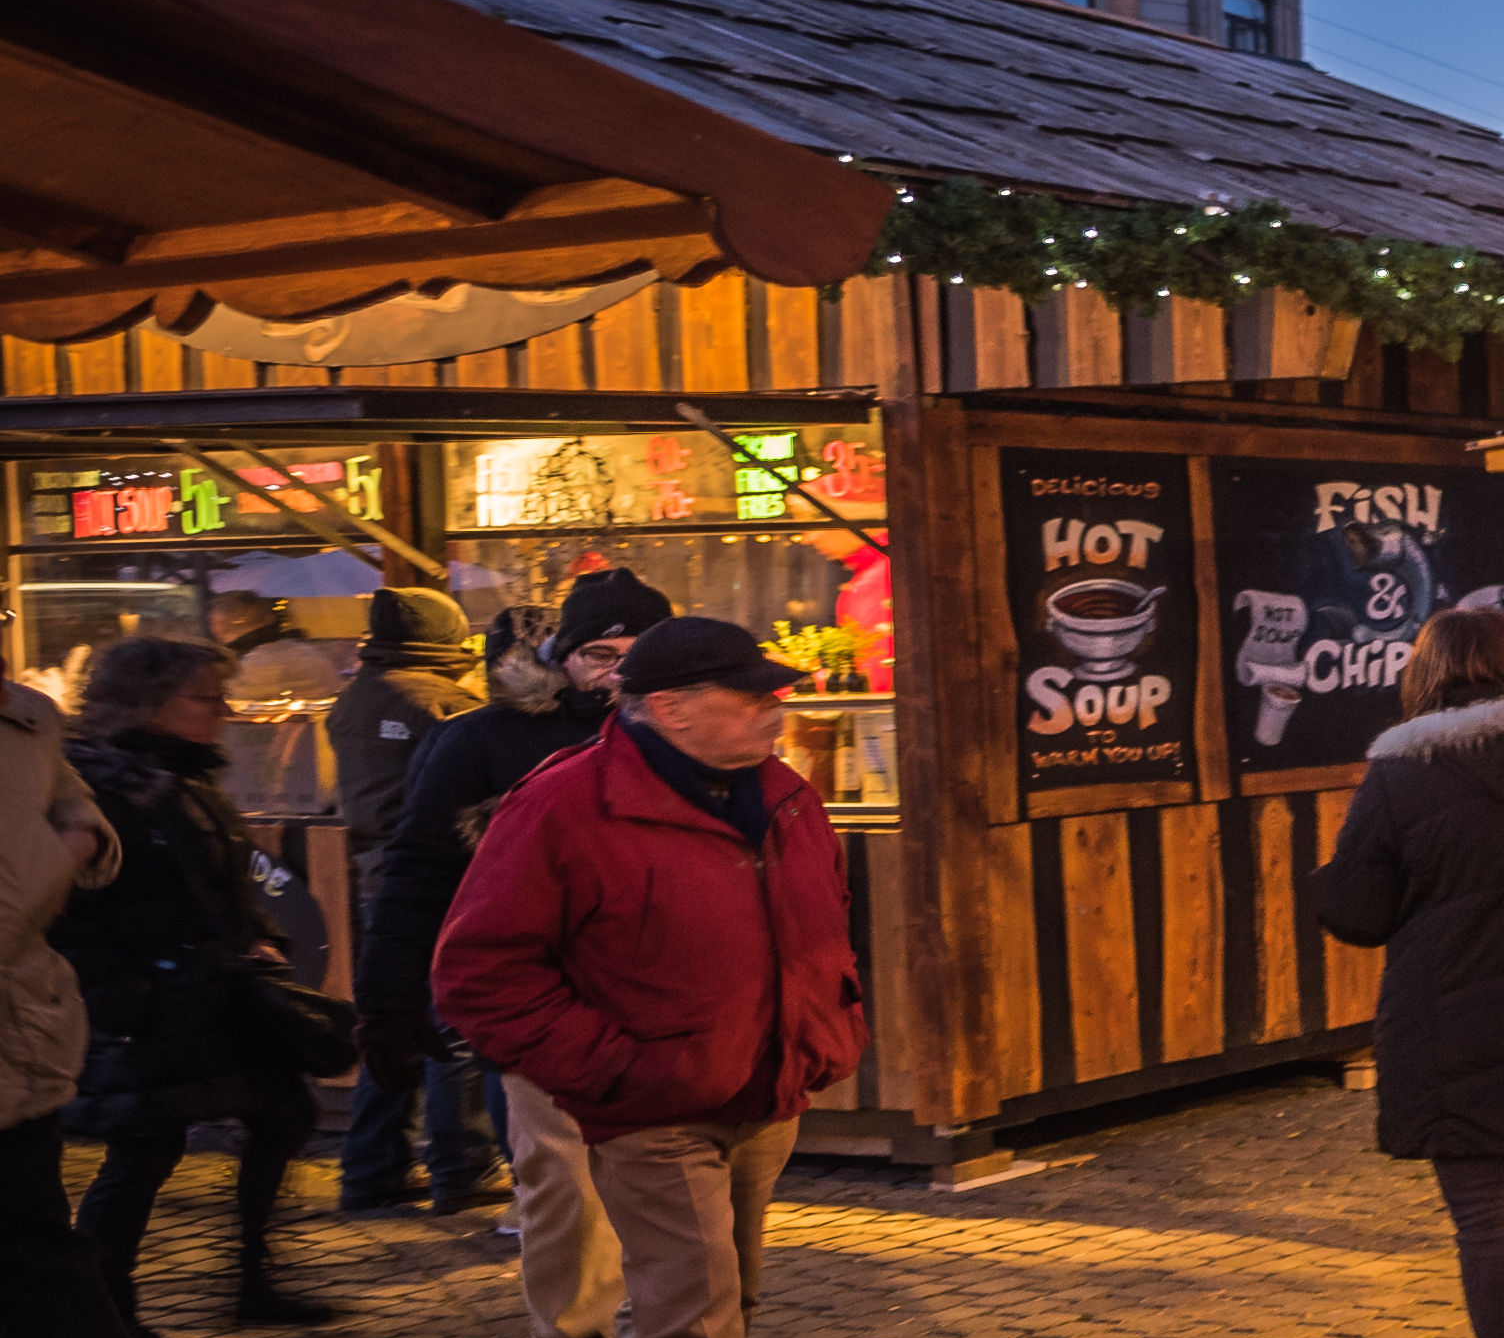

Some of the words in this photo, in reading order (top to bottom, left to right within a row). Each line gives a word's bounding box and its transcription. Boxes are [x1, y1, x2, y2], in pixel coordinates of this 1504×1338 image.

[1042, 517, 1165, 572] HOT
[1365, 572, 1408, 620] &
[1026, 666, 1172, 735] SOUP
